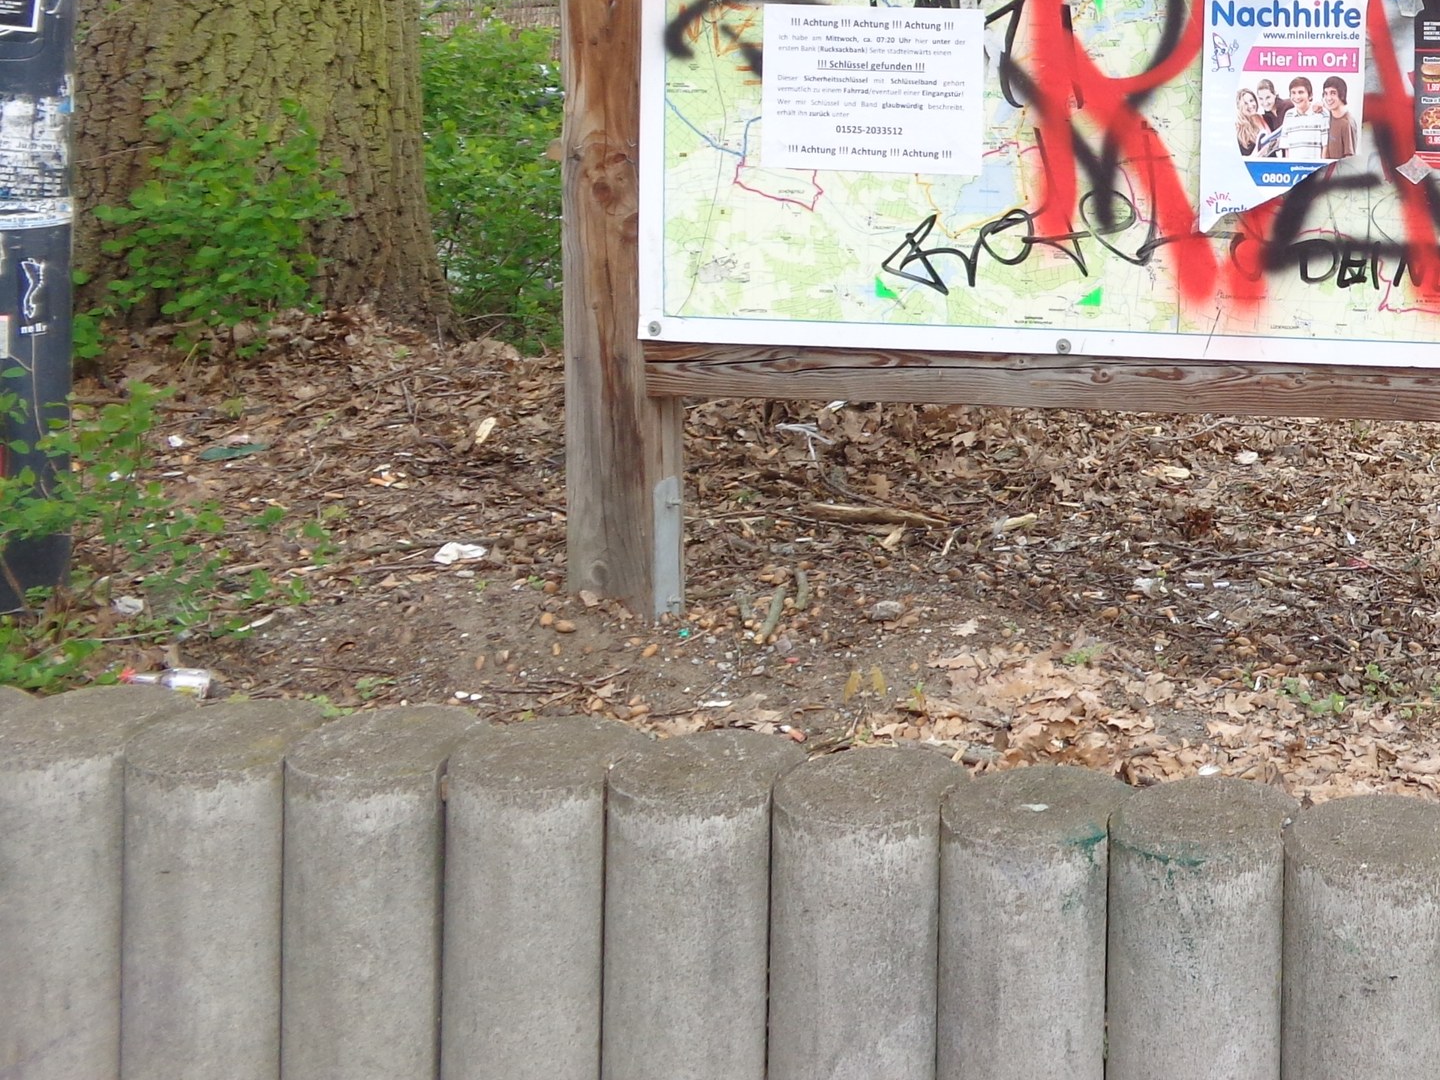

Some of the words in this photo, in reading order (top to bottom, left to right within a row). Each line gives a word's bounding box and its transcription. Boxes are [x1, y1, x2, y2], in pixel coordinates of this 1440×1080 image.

[1212, 0, 1361, 28] Nachhilfe
[803, 19, 838, 28] Achtung
[853, 20, 889, 30] Achtung
[905, 22, 941, 31] Achtung
[1263, 31, 1359, 40] www.minilernkreis.de
[1259, 52, 1292, 66] Hier
[1298, 52, 1317, 66] im
[1323, 53, 1348, 66] Ort
[829, 61, 868, 70] Schlüssel
[871, 62, 912, 71] gefunden
[882, 102, 923, 110] glaubwürdig
[836, 125, 902, 135] 01525-2033512
[801, 145, 836, 155] Achtung
[851, 147, 887, 157] Achtung
[902, 149, 939, 159] Achtung
[1262, 173, 1290, 183] 0800
[1206, 191, 1231, 206] Mini-
